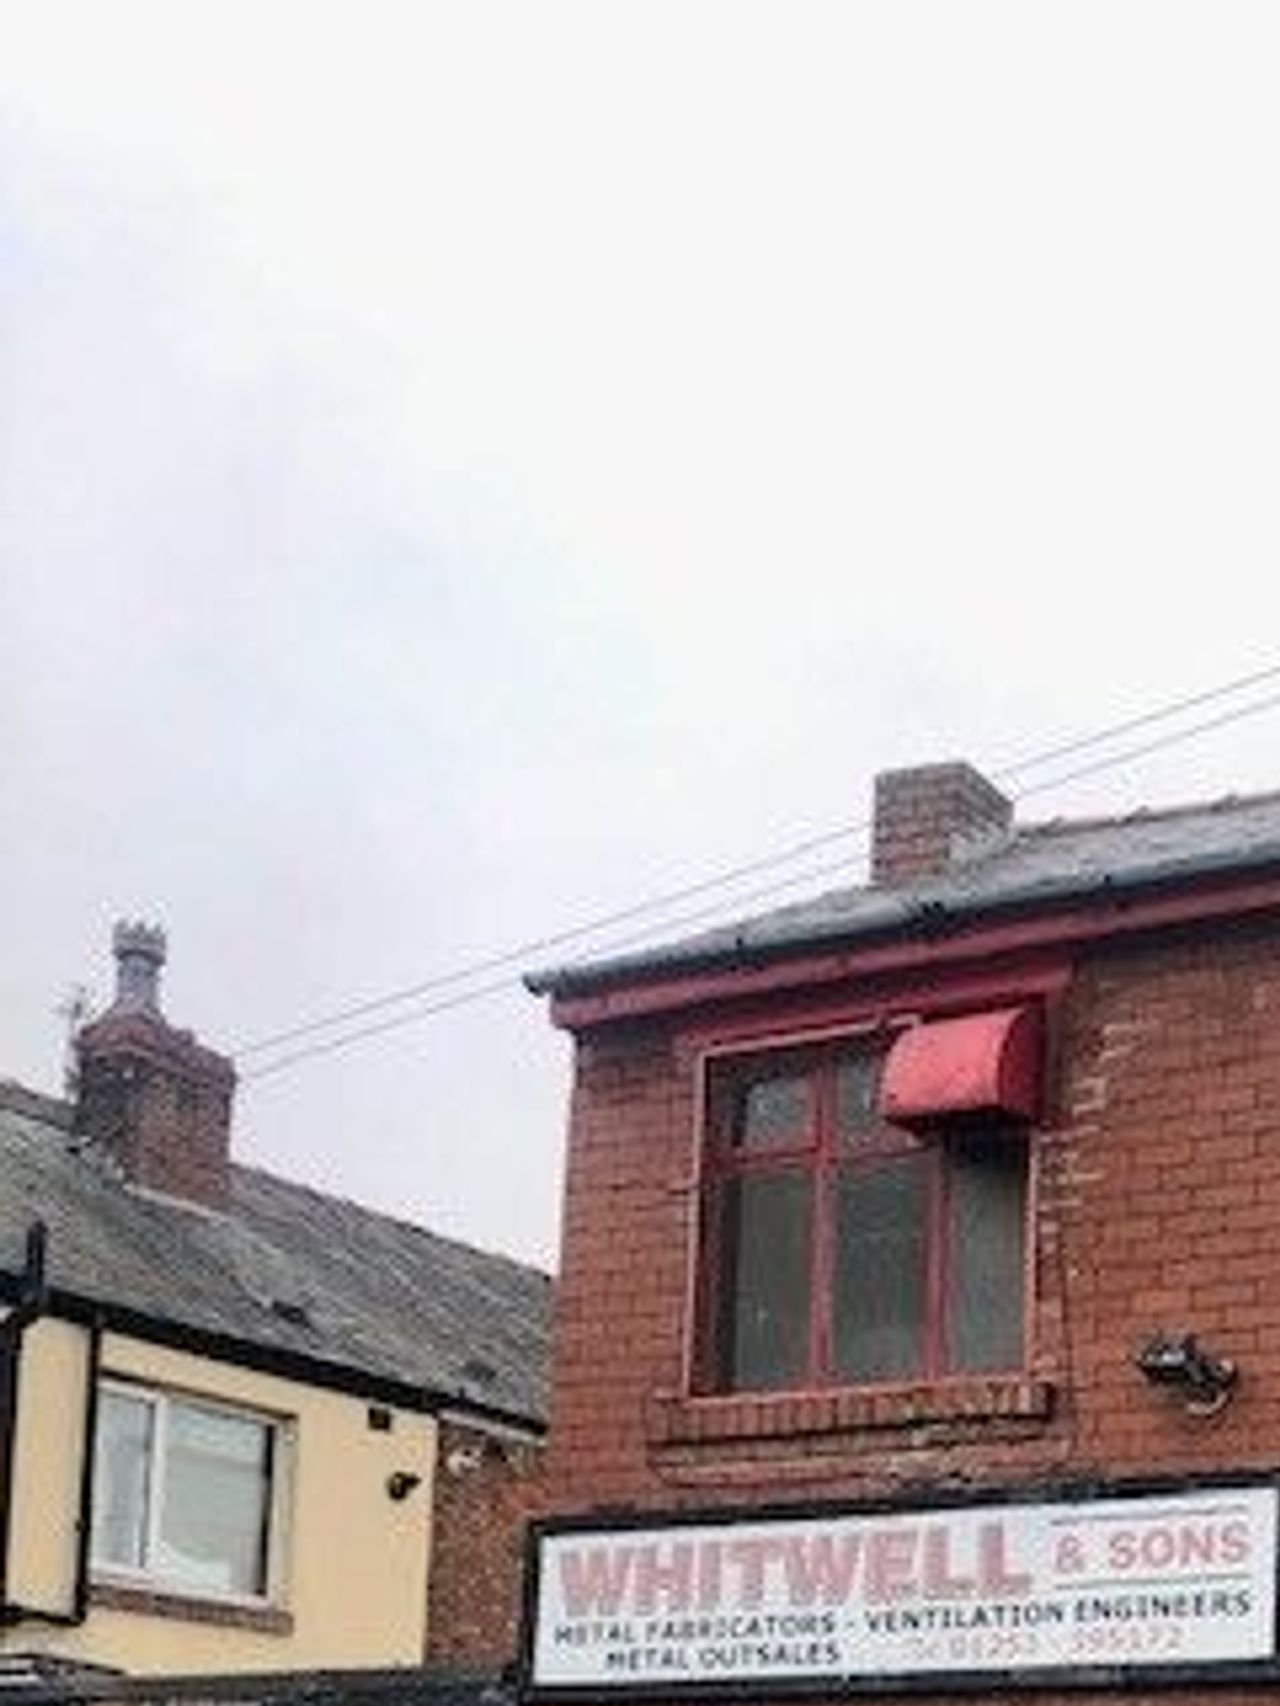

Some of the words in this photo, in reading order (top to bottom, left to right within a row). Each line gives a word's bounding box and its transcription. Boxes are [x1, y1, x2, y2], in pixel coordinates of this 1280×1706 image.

[558, 1522, 1032, 1619] WHITWELL
[1052, 1534, 1087, 1575] &
[1108, 1521, 1252, 1570] SONS
[553, 1619, 636, 1646] METAL
[644, 1610, 837, 1645] FABRICATORS
[863, 1601, 1064, 1634] VENTILATION
[1074, 1589, 1252, 1622] ENGINEERS
[604, 1645, 690, 1671] METAL
[698, 1640, 841, 1670] OUTSALES
